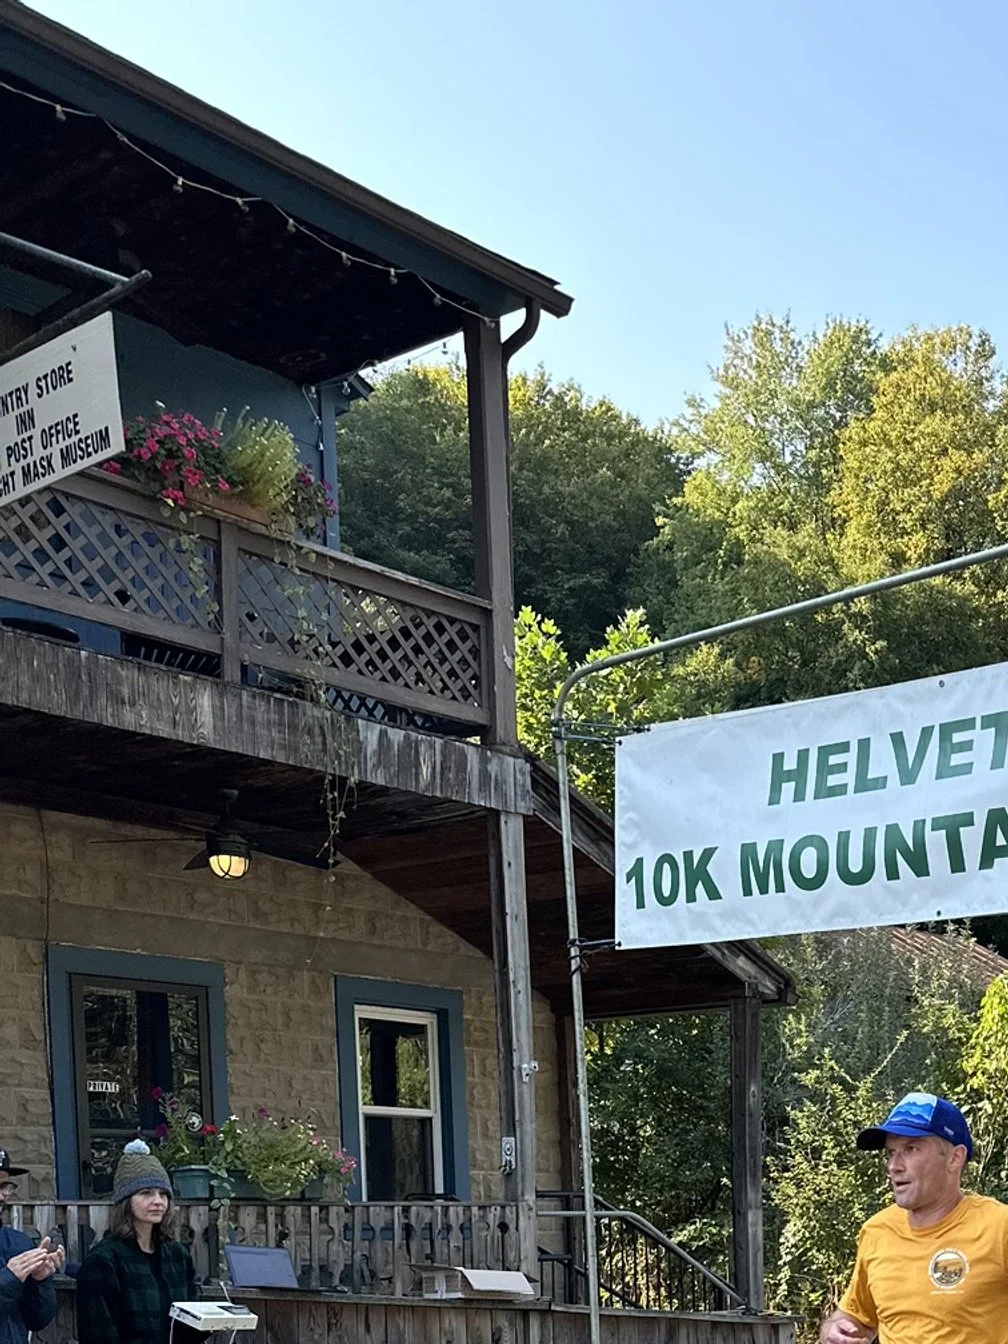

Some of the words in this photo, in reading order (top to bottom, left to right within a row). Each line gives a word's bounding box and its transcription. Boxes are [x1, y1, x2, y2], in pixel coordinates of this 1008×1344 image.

[0, 382, 29, 417] NTRY
[35, 360, 73, 399] STORE
[6, 434, 34, 467] POST
[40, 412, 80, 450] OFFICE
[15, 407, 36, 436] INN
[21, 452, 55, 487] MASK
[60, 425, 111, 469] MUSEUM
[625, 845, 722, 910] 10K
